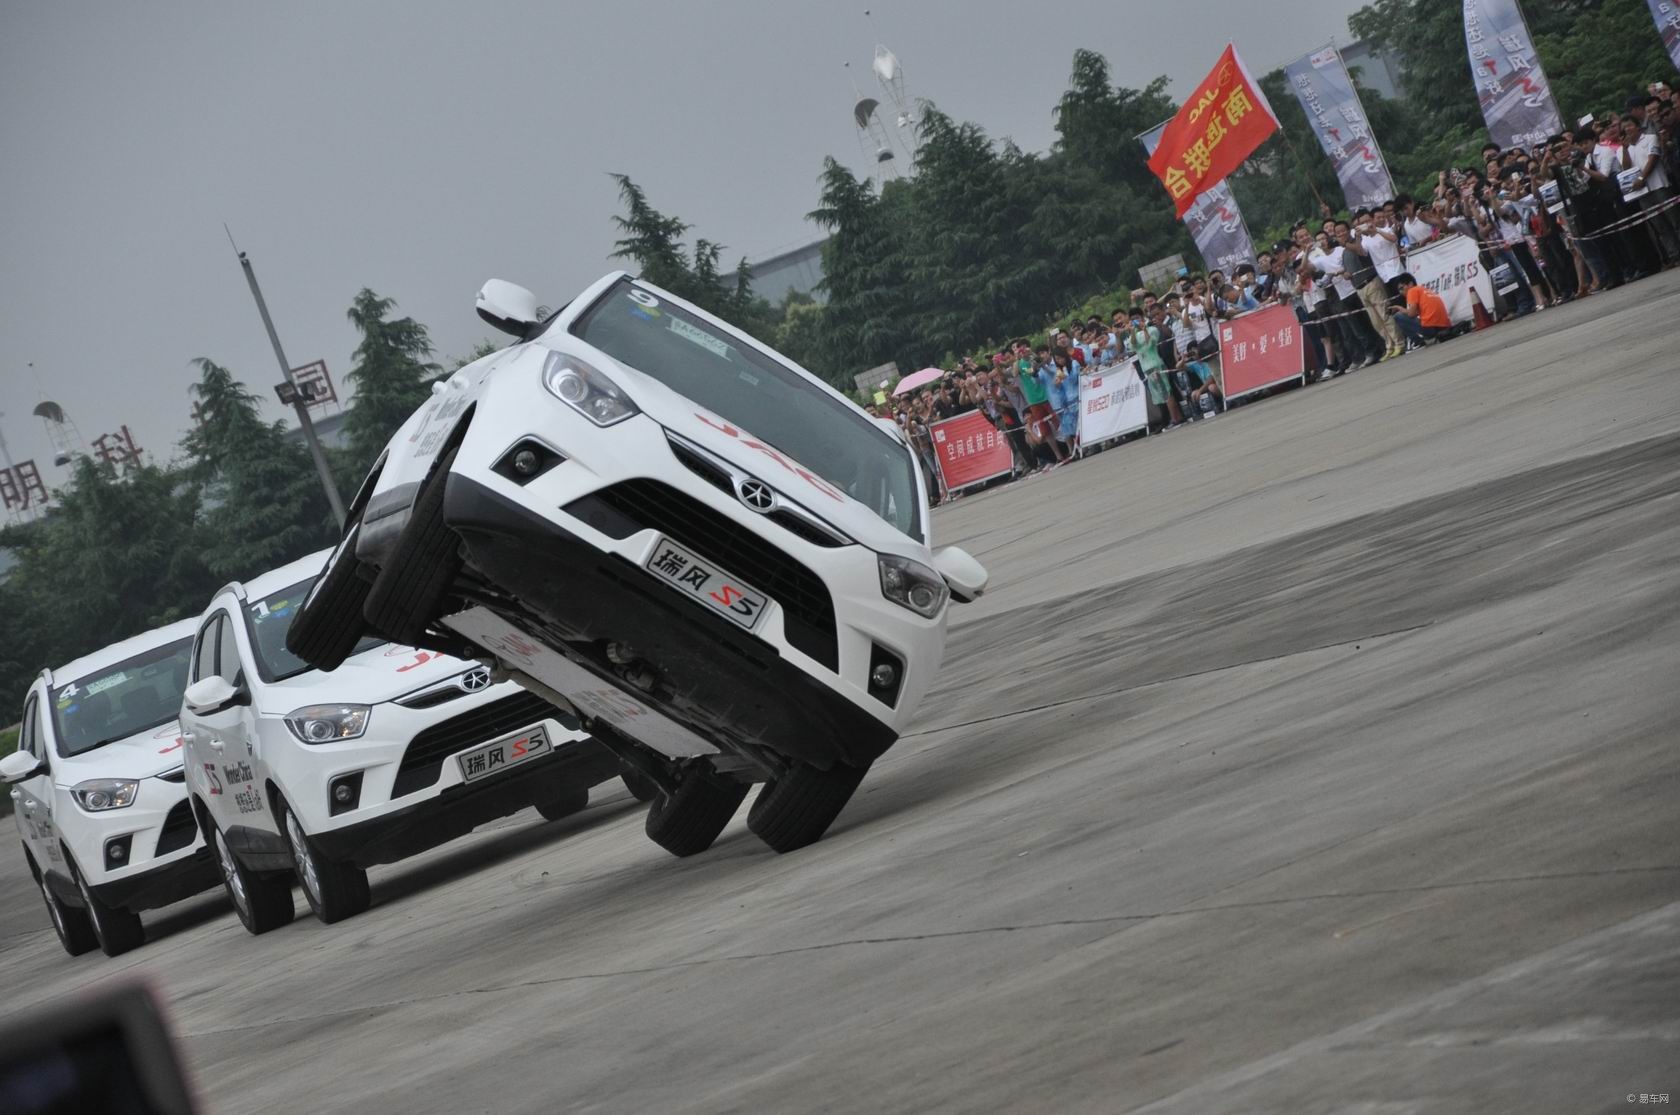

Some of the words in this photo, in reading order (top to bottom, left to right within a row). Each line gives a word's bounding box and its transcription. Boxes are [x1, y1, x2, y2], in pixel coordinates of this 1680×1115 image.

[627, 288, 659, 308] 9
[694, 412, 845, 503] JAC
[653, 549, 711, 591] 瑞风
[708, 584, 759, 616] S5
[58, 683, 80, 702] 4
[467, 747, 505, 775] 瑞风
[511, 733, 544, 760] S5
